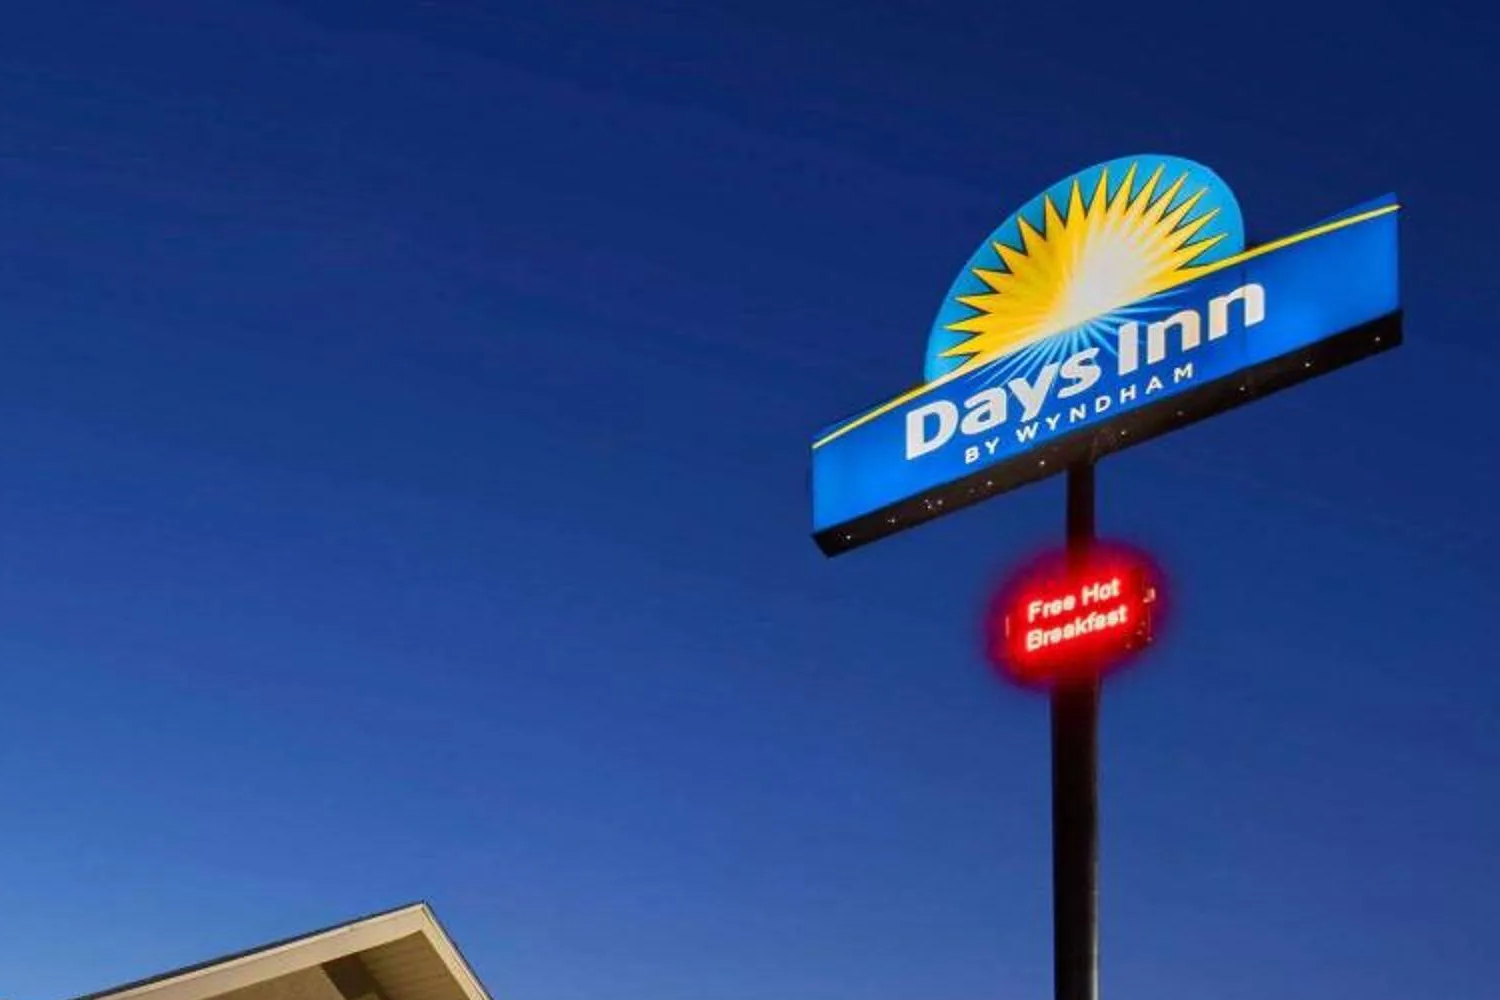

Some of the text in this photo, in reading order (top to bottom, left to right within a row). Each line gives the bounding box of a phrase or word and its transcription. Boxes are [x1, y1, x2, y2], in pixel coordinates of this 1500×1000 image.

[905, 282, 1266, 461] Days Inn
[964, 362, 1195, 465] BY WYNDHAM
[1026, 604, 1128, 652] Breakfast
[1027, 577, 1121, 623] Free Hot
